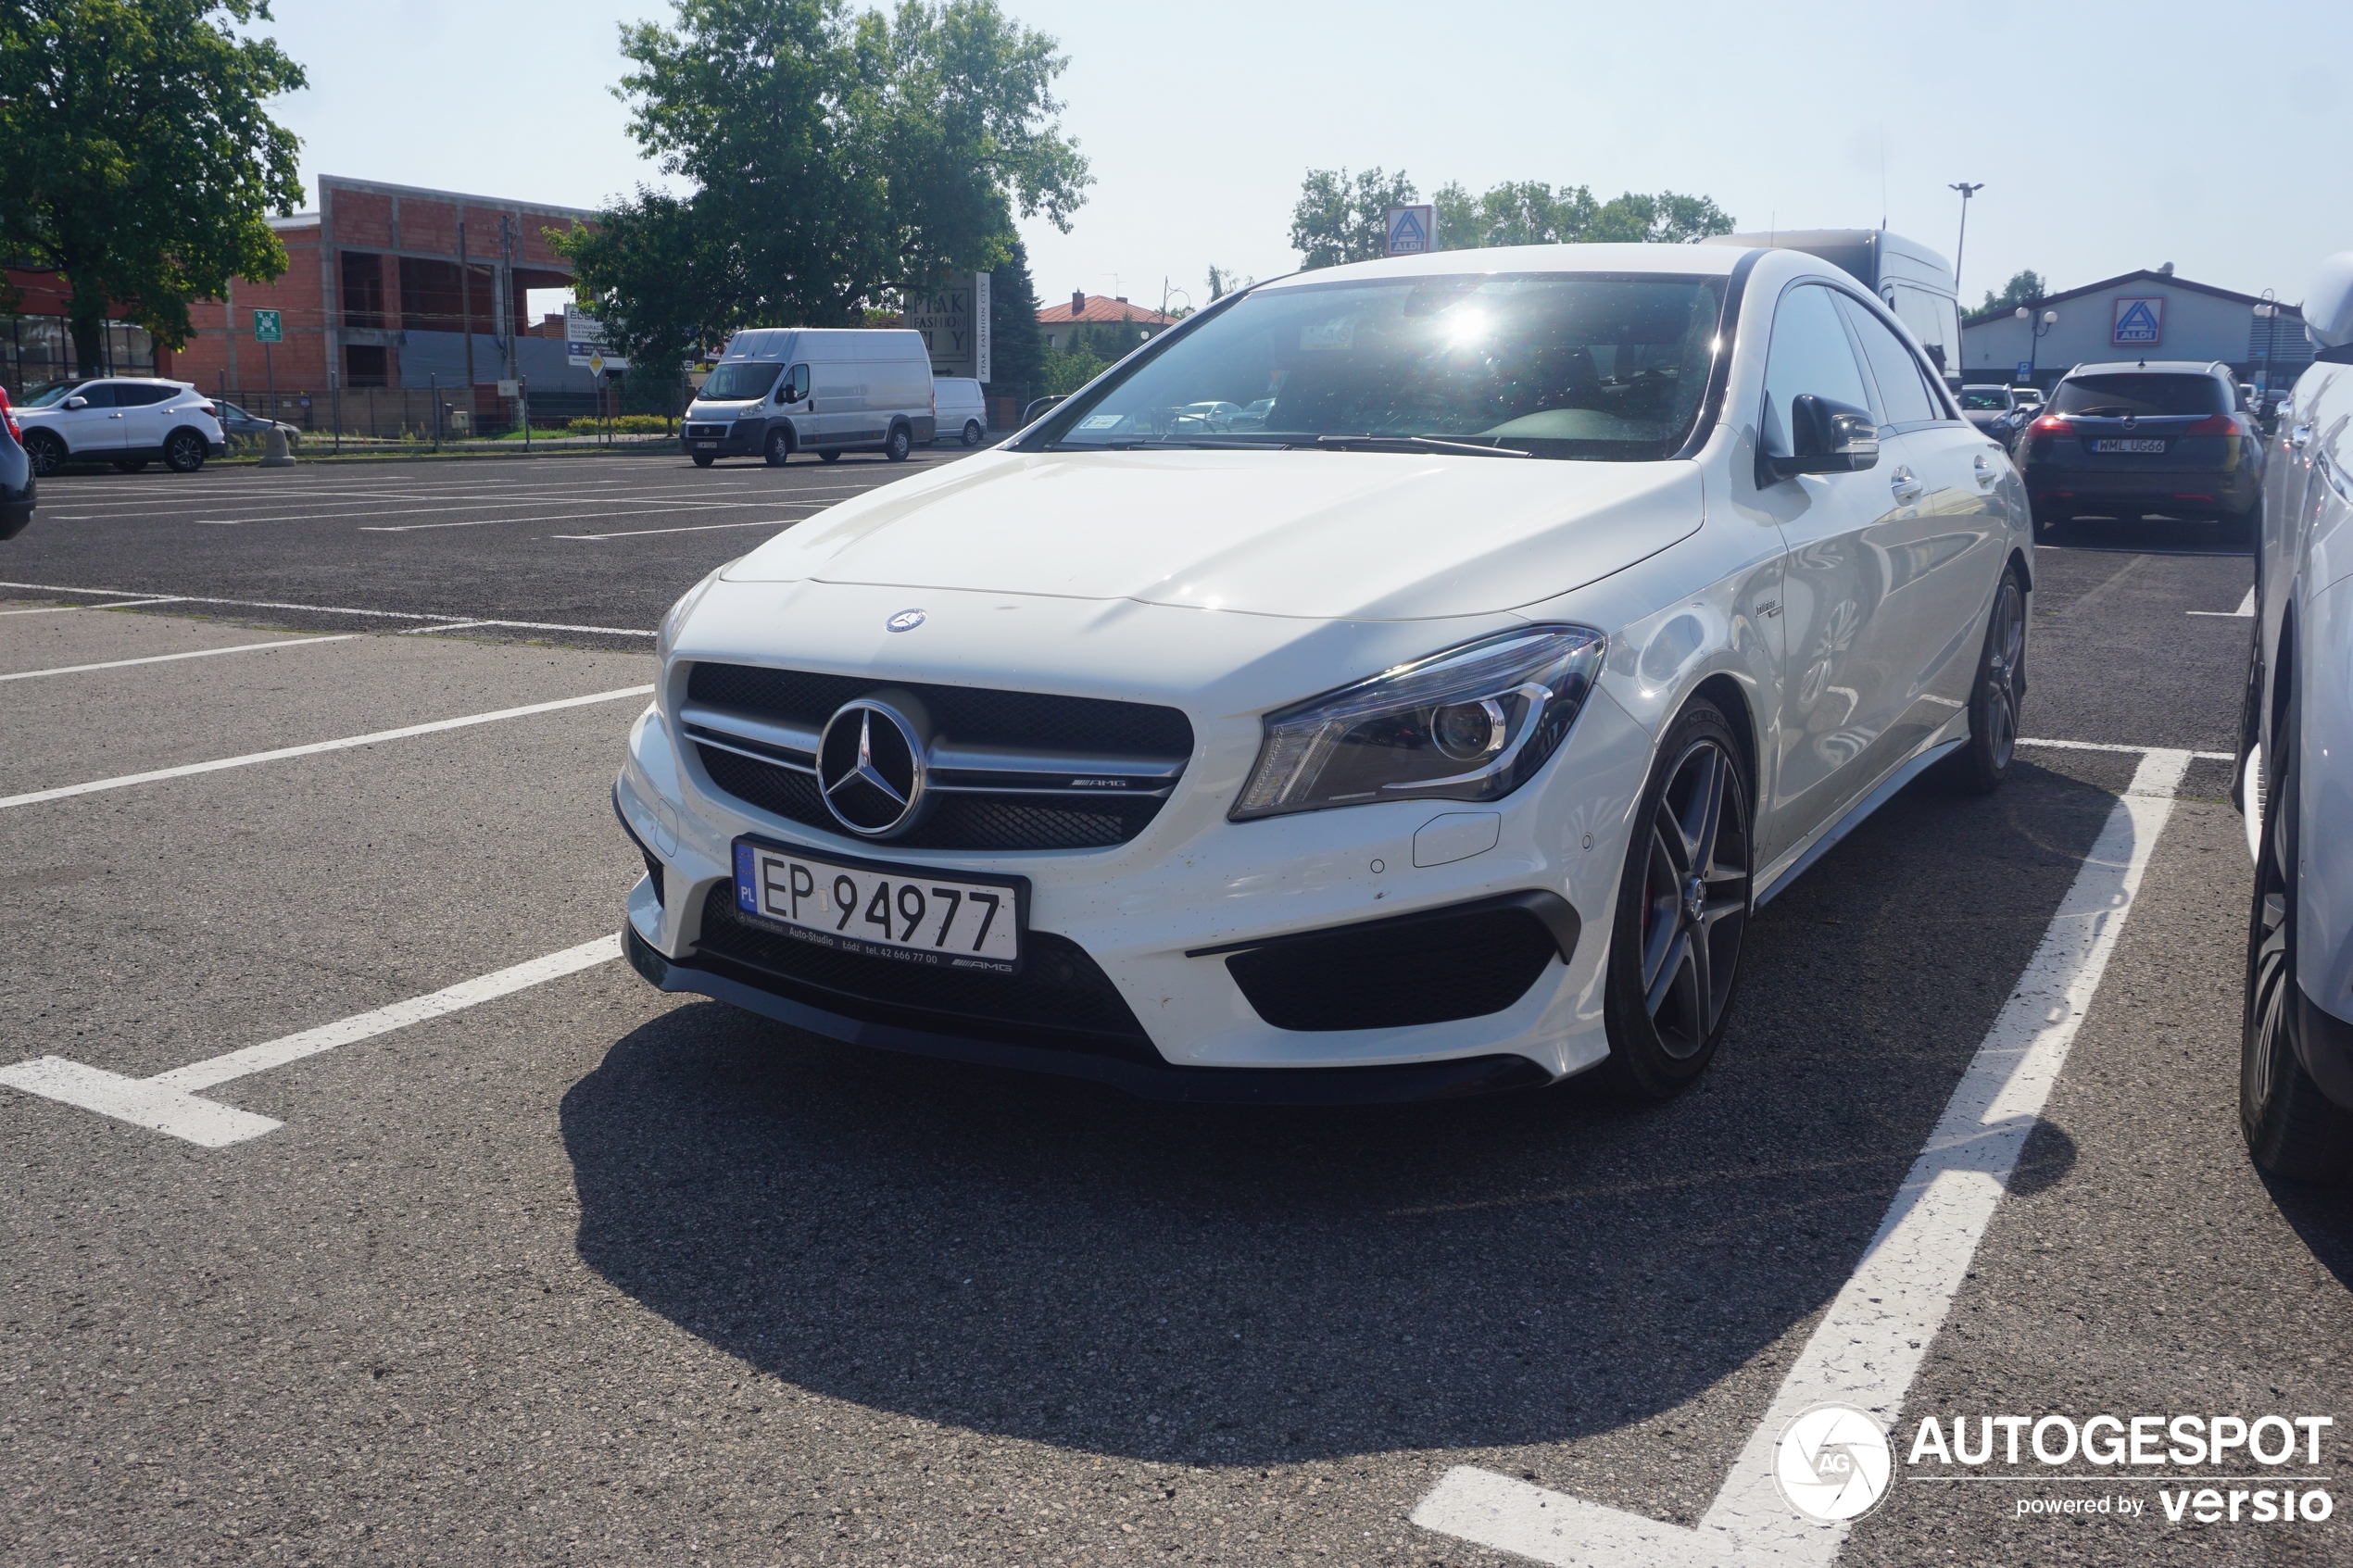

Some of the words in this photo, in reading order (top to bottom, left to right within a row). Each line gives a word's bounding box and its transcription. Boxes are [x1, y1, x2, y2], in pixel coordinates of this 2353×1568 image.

[1393, 242, 1422, 250] ALDI
[914, 316, 966, 328] FASHION
[2120, 331, 2154, 339] ALDI
[2020, 363, 2029, 373] P
[2099, 440, 2126, 451] WML
[2131, 440, 2163, 452] UG66
[741, 885, 755, 903] PL
[761, 857, 814, 920] EP
[834, 875, 1000, 951] 94977
[789, 927, 834, 946] Auto-Studio
[842, 940, 861, 952] Łódź
[865, 946, 879, 955] tel.
[881, 947, 892, 958] 42
[894, 950, 911, 960] 666
[913, 953, 923, 962] 77
[926, 955, 937, 964] 00
[970, 960, 1013, 972] AMG
